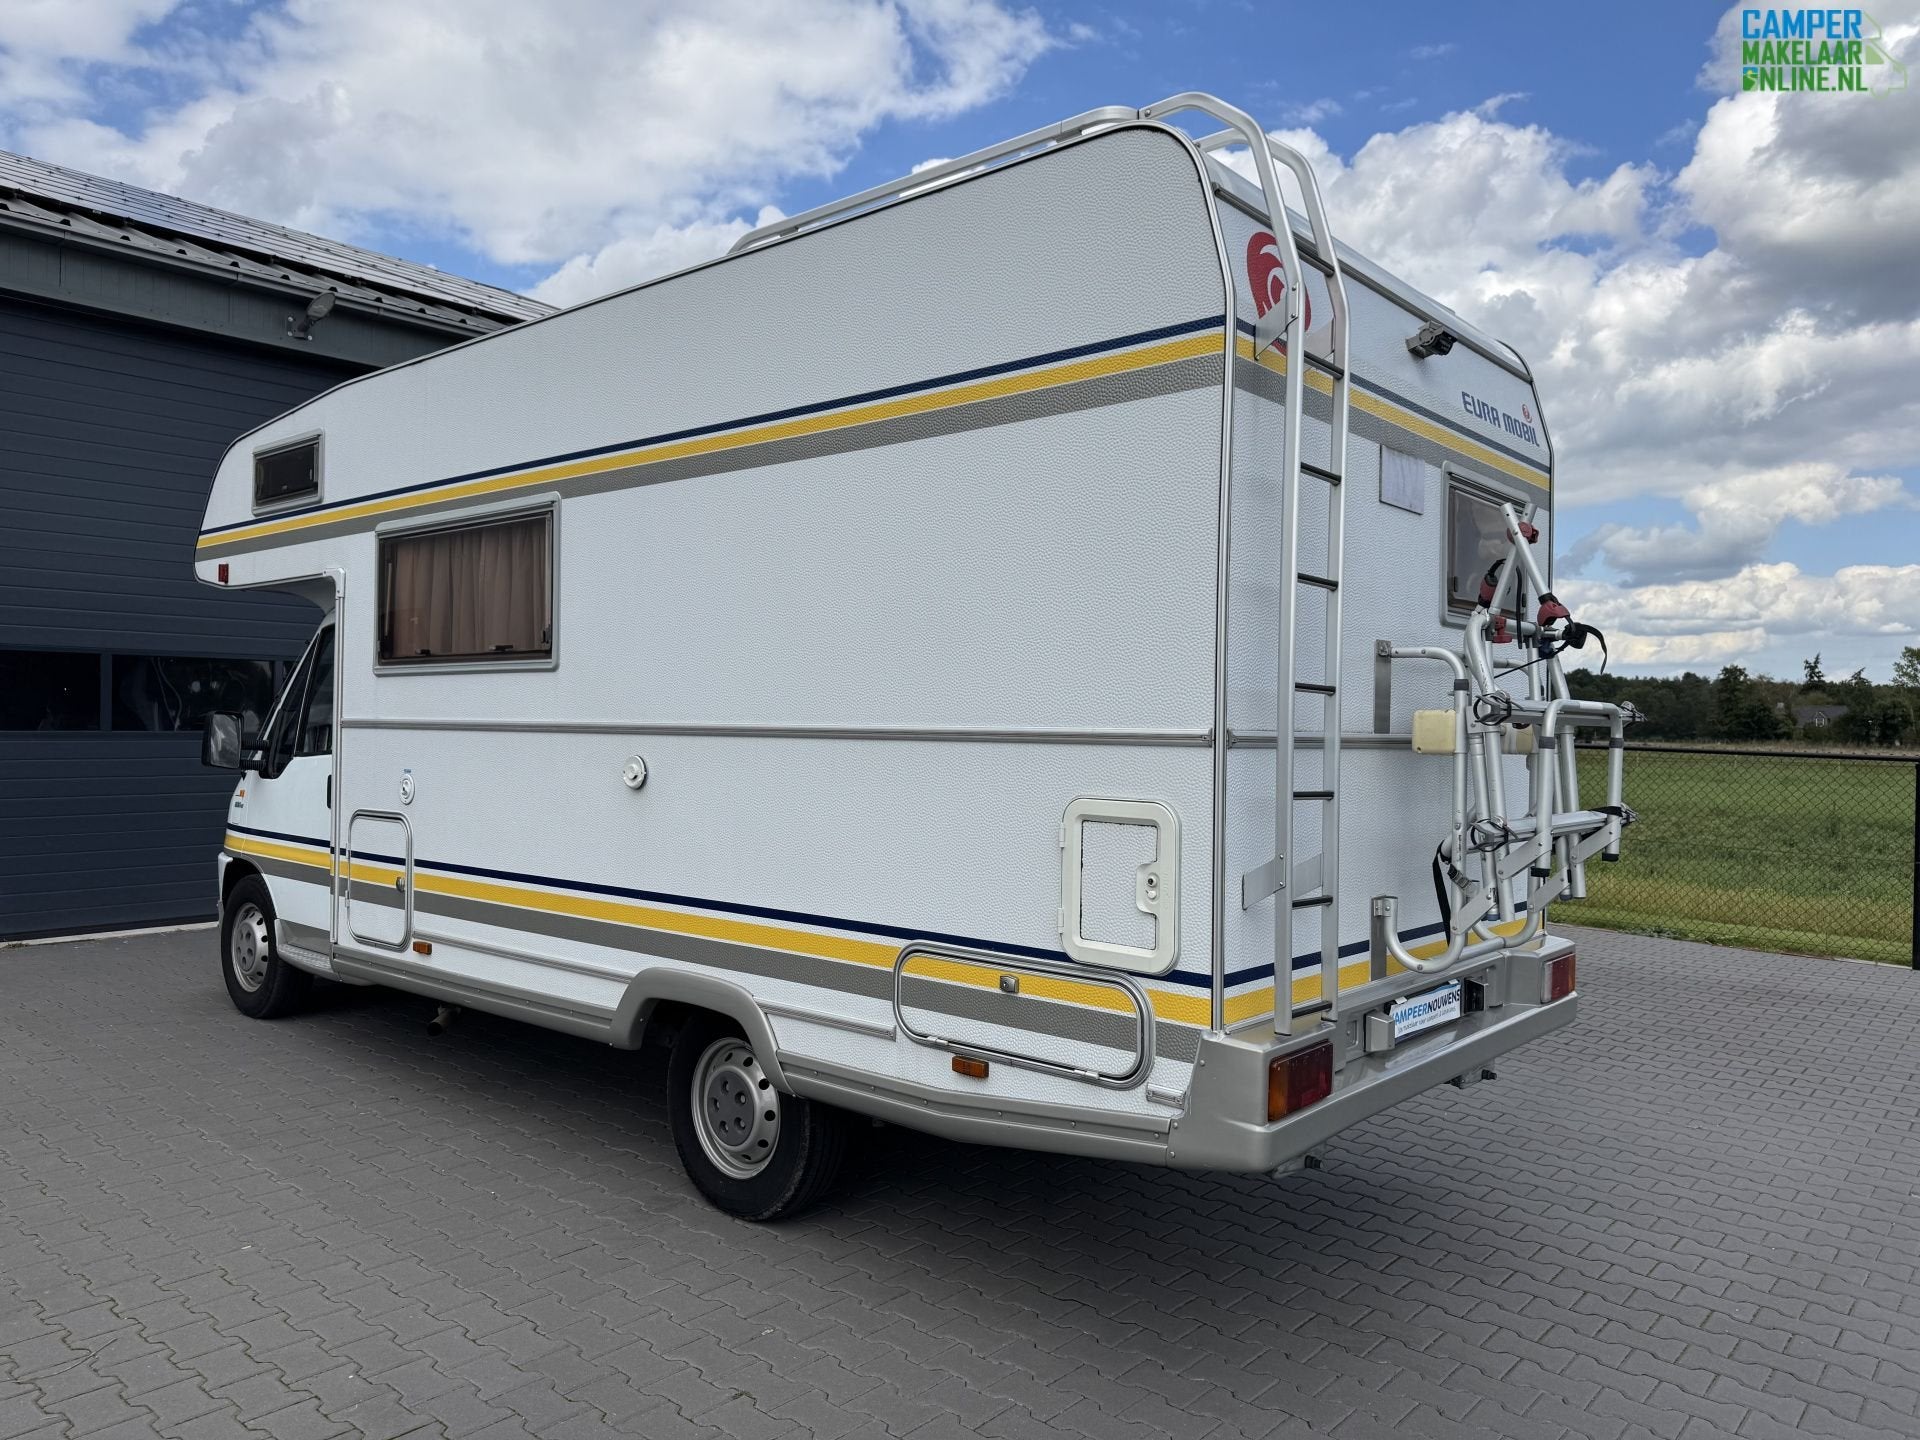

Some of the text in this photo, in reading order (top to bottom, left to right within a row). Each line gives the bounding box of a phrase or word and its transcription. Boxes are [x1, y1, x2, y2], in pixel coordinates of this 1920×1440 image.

[1461, 391, 1540, 447] EURA MOBIL
[1393, 989, 1460, 1025] AMPEERNOUWENS
